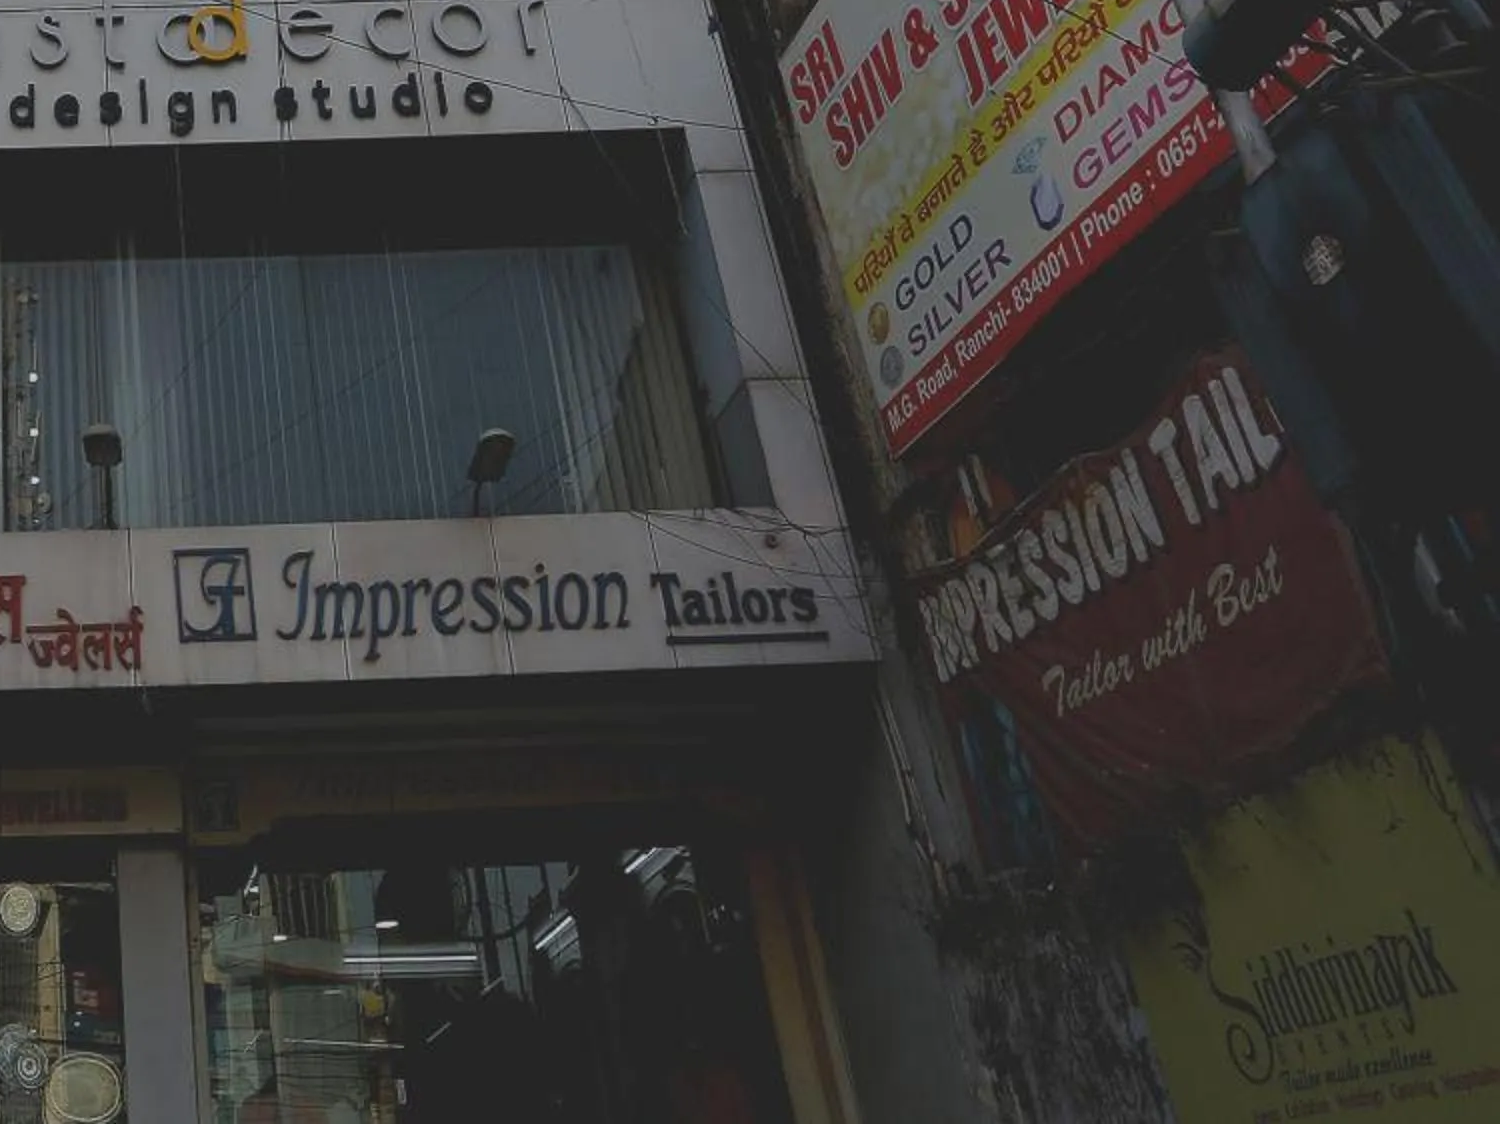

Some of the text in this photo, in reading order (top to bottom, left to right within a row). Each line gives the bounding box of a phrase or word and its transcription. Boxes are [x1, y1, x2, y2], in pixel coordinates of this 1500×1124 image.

[8, 71, 495, 136] design studio
[789, 18, 845, 126] SRI
[824, 28, 906, 170] SHIV
[902, 6, 941, 72] &
[895, 213, 974, 311] GOLD
[907, 239, 1012, 357] SILVER
[1011, 242, 1069, 313] 834001
[1078, 180, 1144, 249] Phone
[918, 367, 1285, 684] IMPRESSION TAIL
[25, 605, 145, 672] ज्वेलर्स
[276, 550, 819, 661] Impression Tailors
[1041, 542, 1284, 719] Tailor with Best
[1225, 906, 1460, 1086] Siddhivinayak
